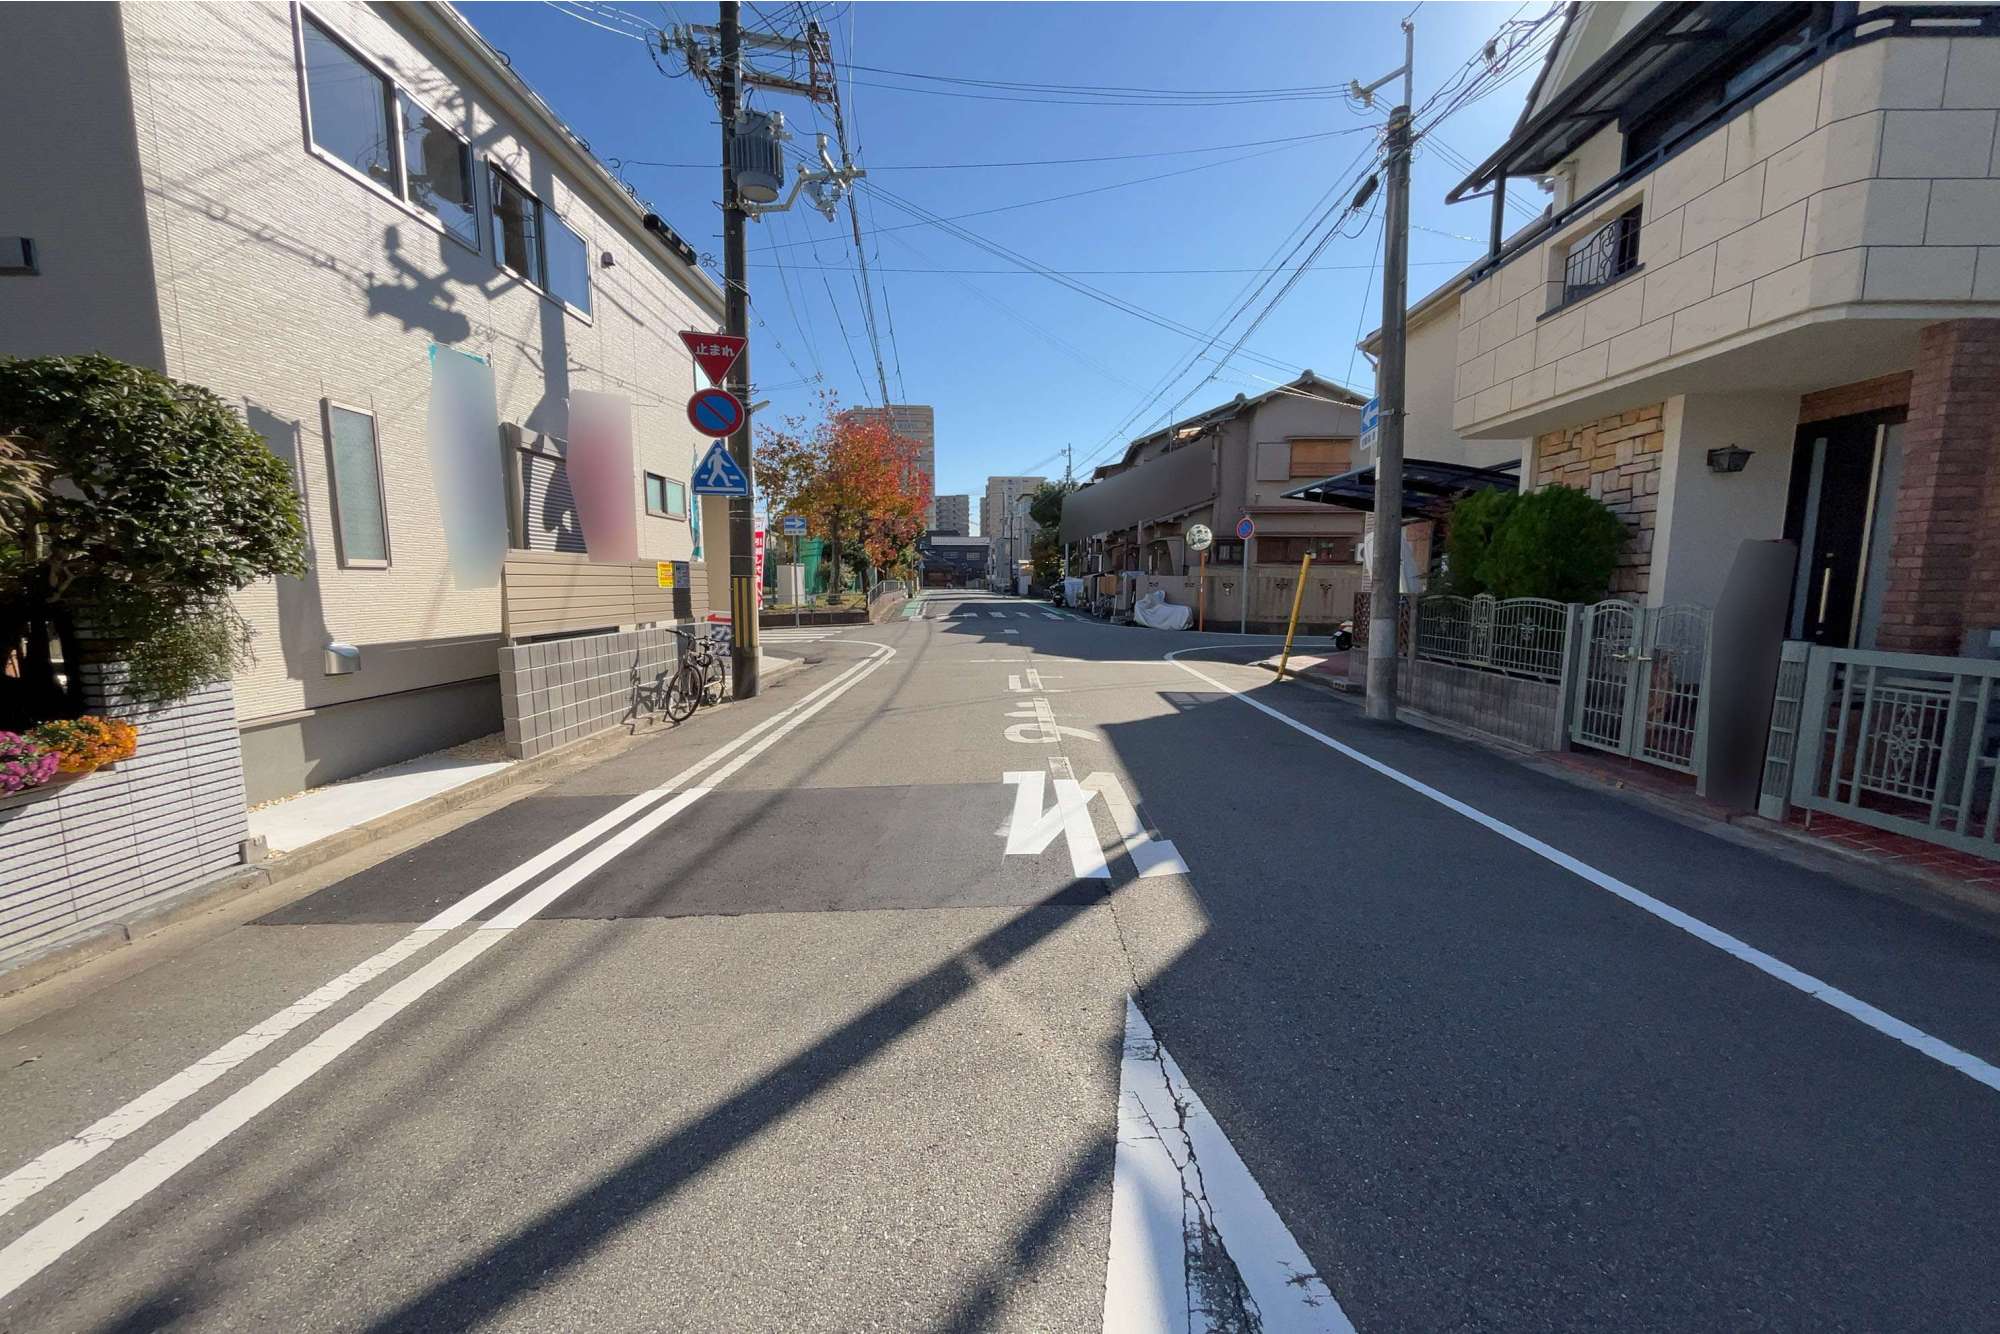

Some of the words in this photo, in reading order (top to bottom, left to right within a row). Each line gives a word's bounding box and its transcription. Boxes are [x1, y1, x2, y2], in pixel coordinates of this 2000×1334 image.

[695, 343, 735, 357] 止まれ
[1002, 668, 1190, 878] 止まれ
